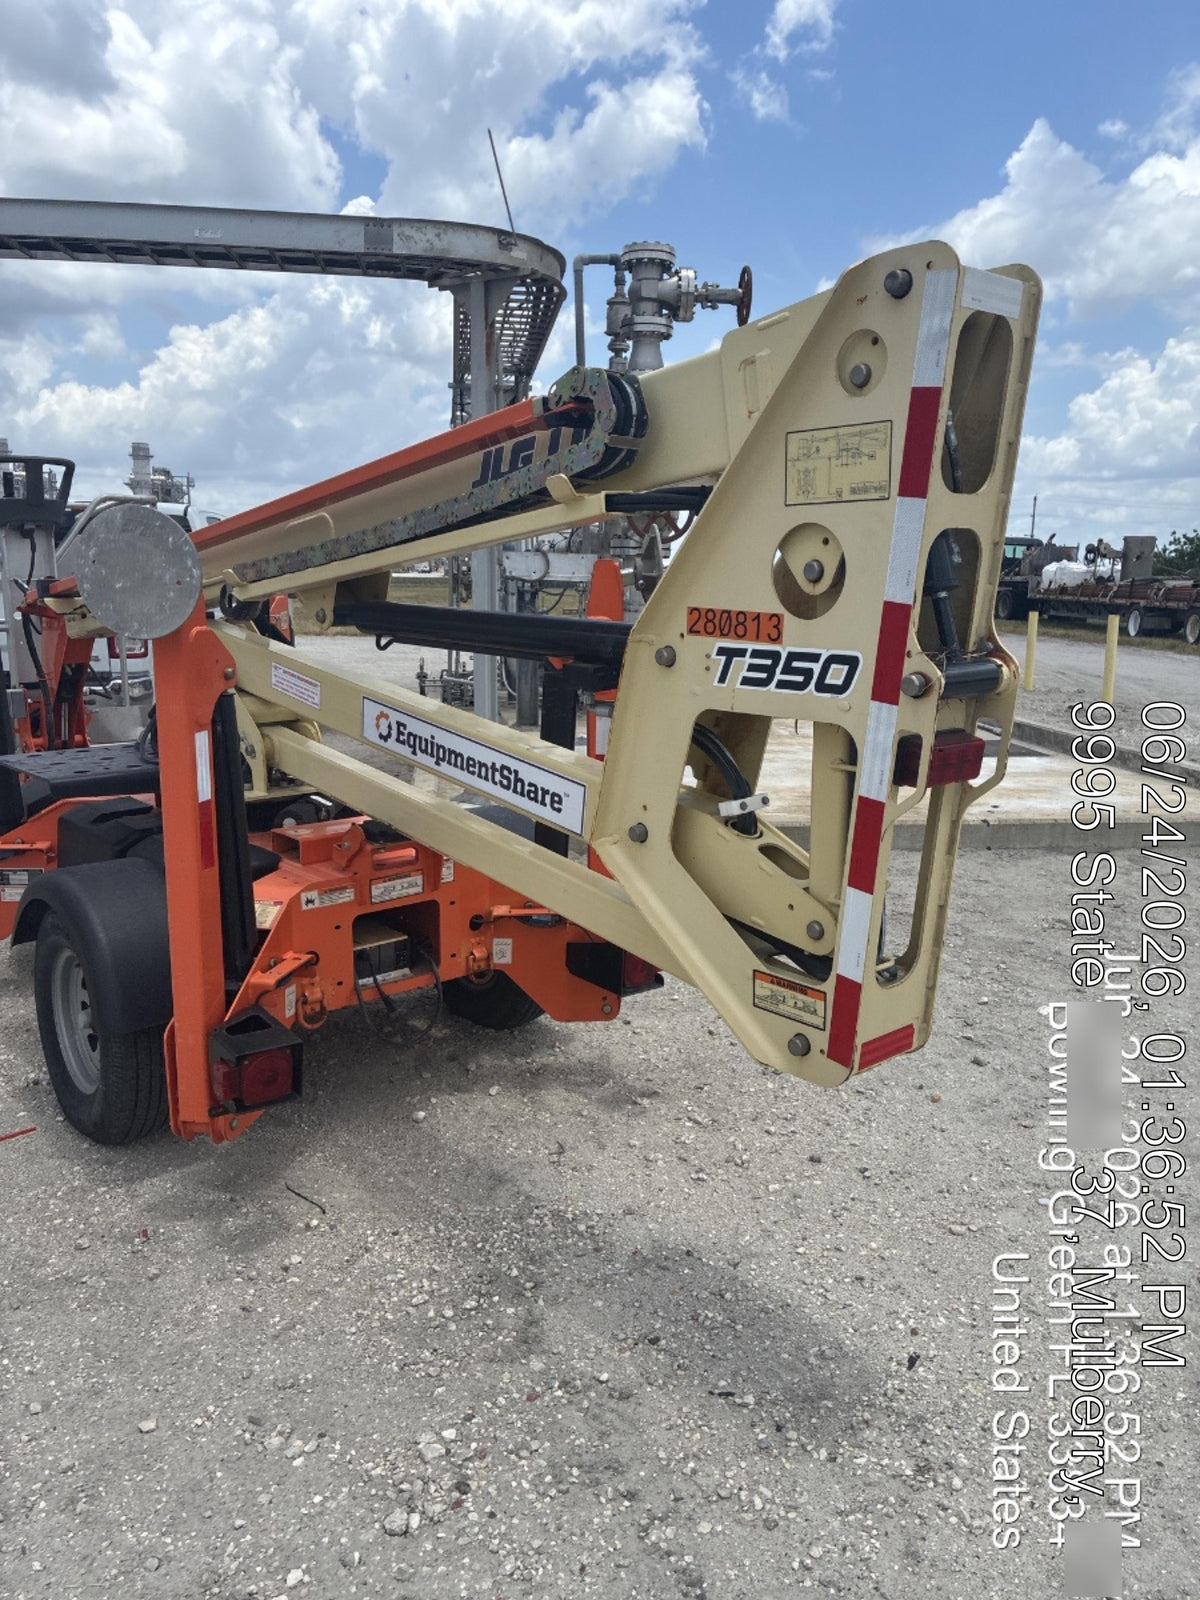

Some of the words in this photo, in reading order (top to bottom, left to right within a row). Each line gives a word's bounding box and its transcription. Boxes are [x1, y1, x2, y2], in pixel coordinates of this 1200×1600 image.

[688, 606, 782, 642] 280813
[714, 645, 862, 697] T350
[395, 719, 564, 815] EquipmentShare
